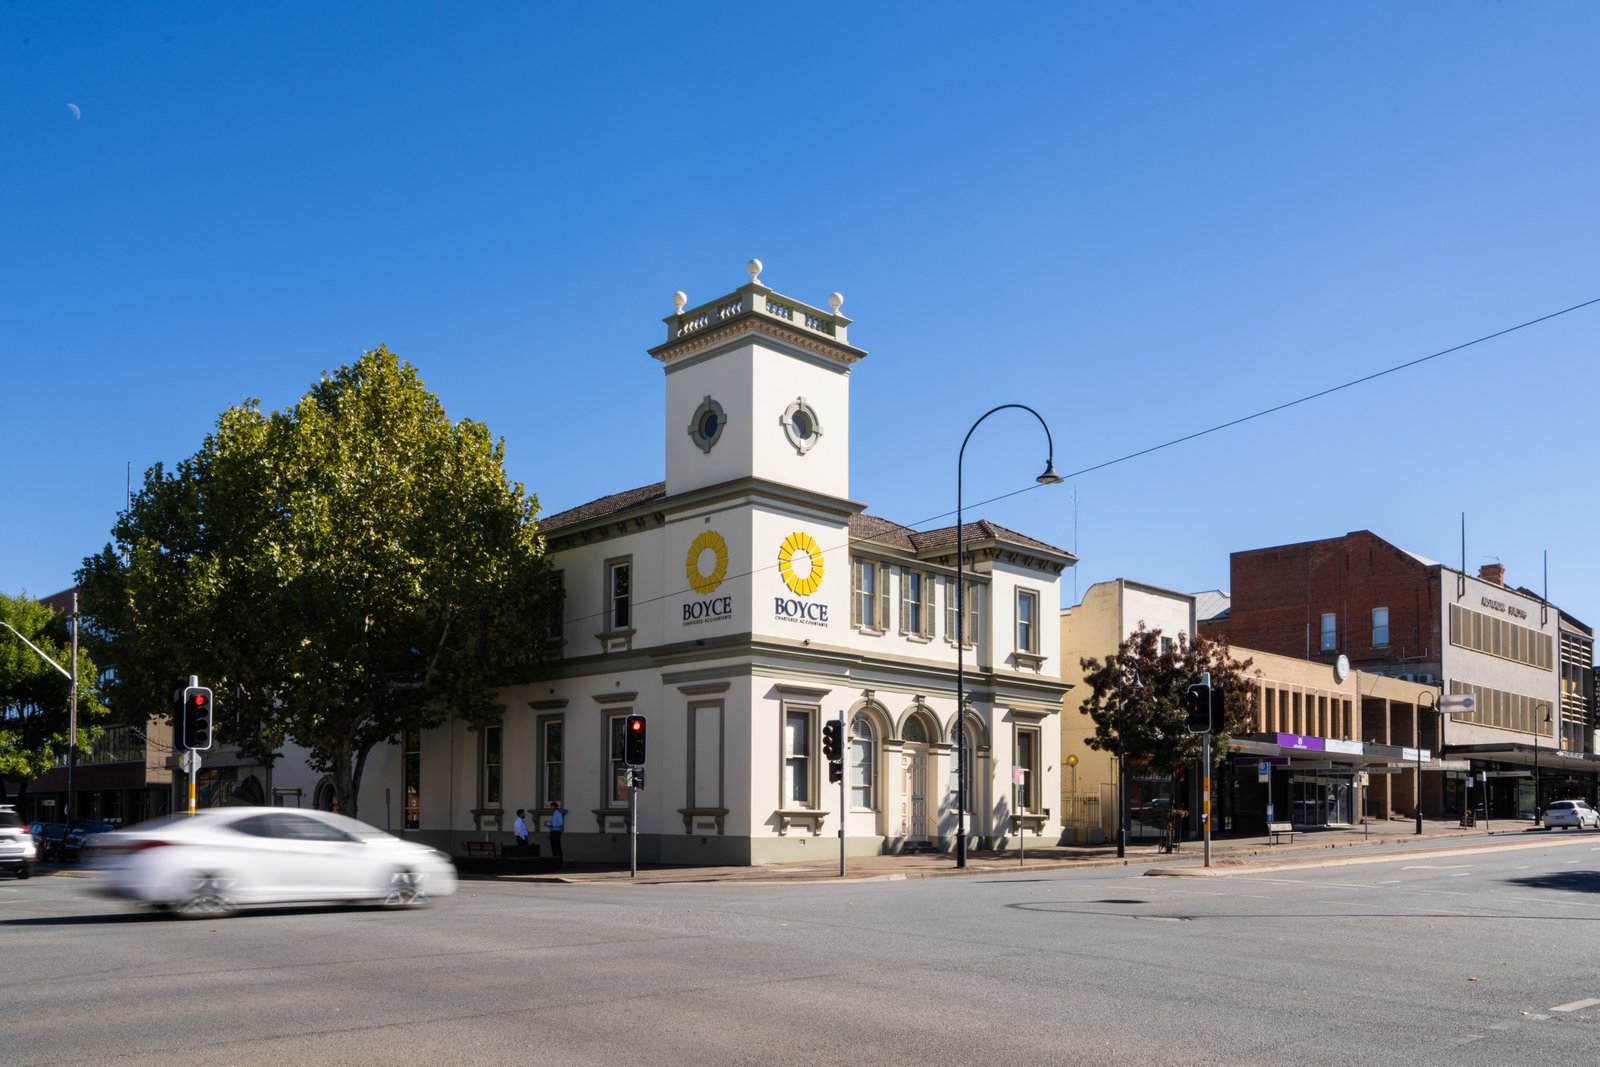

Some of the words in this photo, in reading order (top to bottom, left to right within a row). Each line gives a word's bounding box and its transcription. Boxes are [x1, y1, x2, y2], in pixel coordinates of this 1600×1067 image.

[682, 596, 732, 621] BOYCE
[774, 597, 829, 622] BOYCE
[774, 615, 798, 623] CHARTERED
[799, 619, 828, 628] ACCOUNTANTS
